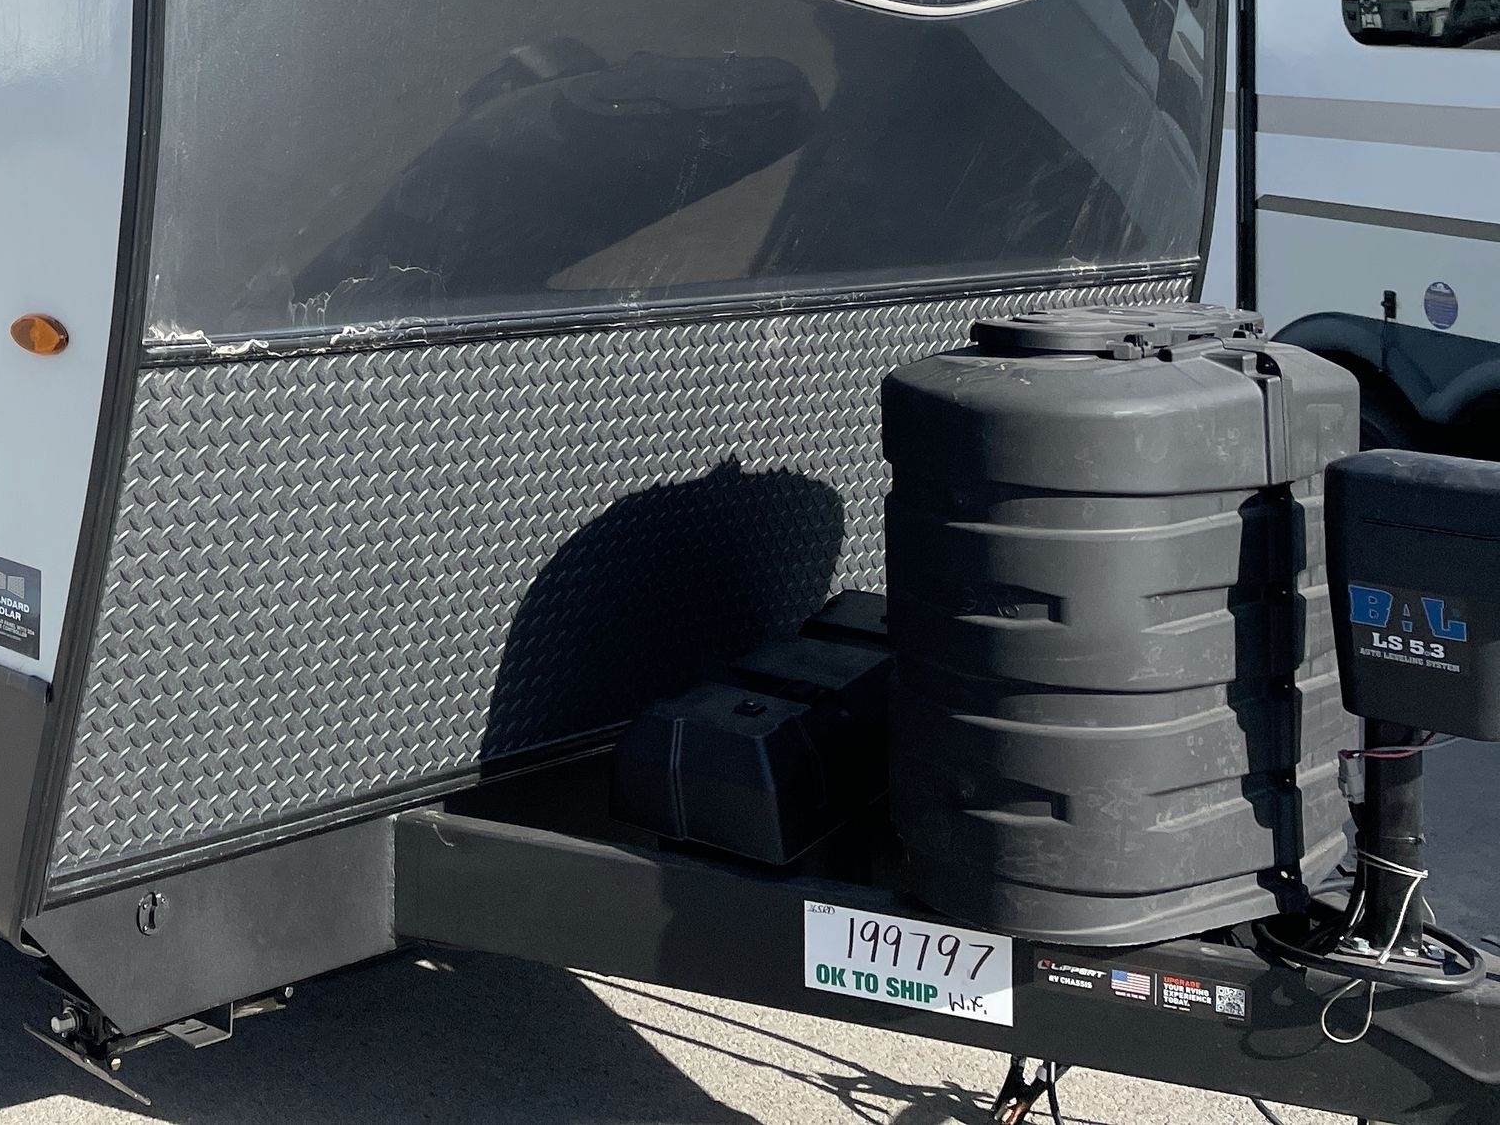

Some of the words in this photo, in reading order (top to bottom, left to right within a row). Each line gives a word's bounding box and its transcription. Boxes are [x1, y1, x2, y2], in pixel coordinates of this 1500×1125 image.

[1372, 632, 1403, 651] LS
[1409, 639, 1445, 659] 5.3
[1383, 651, 1424, 666] LEVELING
[1426, 659, 1461, 673] SYSTEM
[847, 917, 995, 980] 199797
[816, 963, 847, 988] OK
[852, 970, 879, 994] TO
[886, 976, 938, 1004] SHIP
[1060, 975, 1093, 989] CHASSIS
[1163, 976, 1202, 988] UPGRADE
[1163, 983, 1185, 993] YOUR
[1163, 989, 1212, 1005] EXPERIENCE
